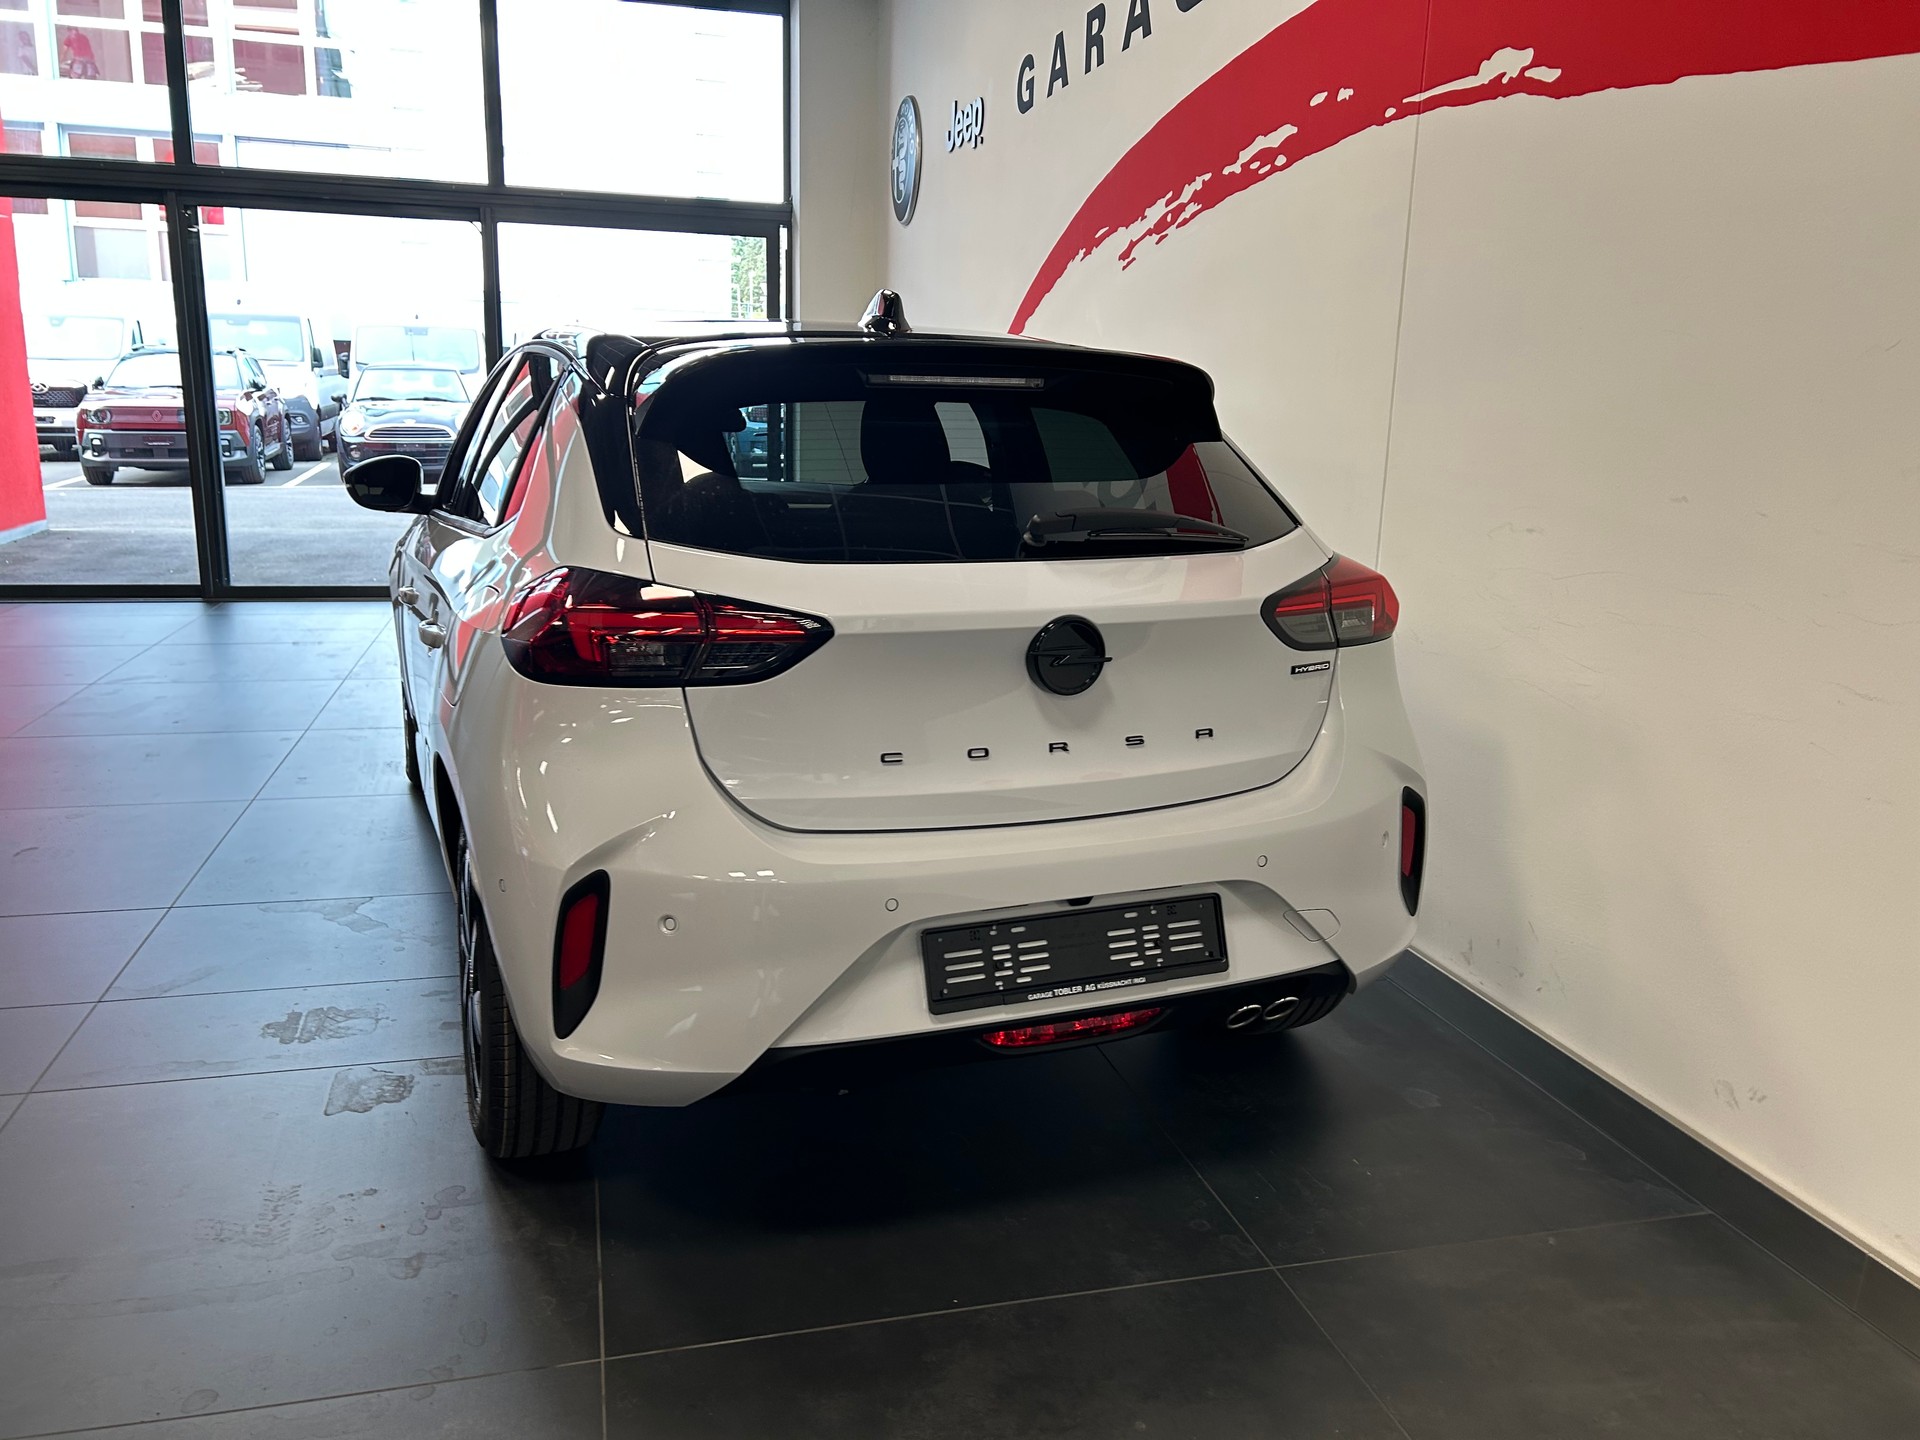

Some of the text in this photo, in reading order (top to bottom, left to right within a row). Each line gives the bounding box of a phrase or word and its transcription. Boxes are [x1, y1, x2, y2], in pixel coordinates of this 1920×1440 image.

[1016, 0, 1203, 115] GARA
[944, 97, 985, 153] Jeep
[1295, 663, 1330, 673] HYBRID
[880, 728, 1214, 764] CORSA
[1028, 991, 1053, 1000] GARAGE
[1054, 986, 1082, 996] TOBLER
